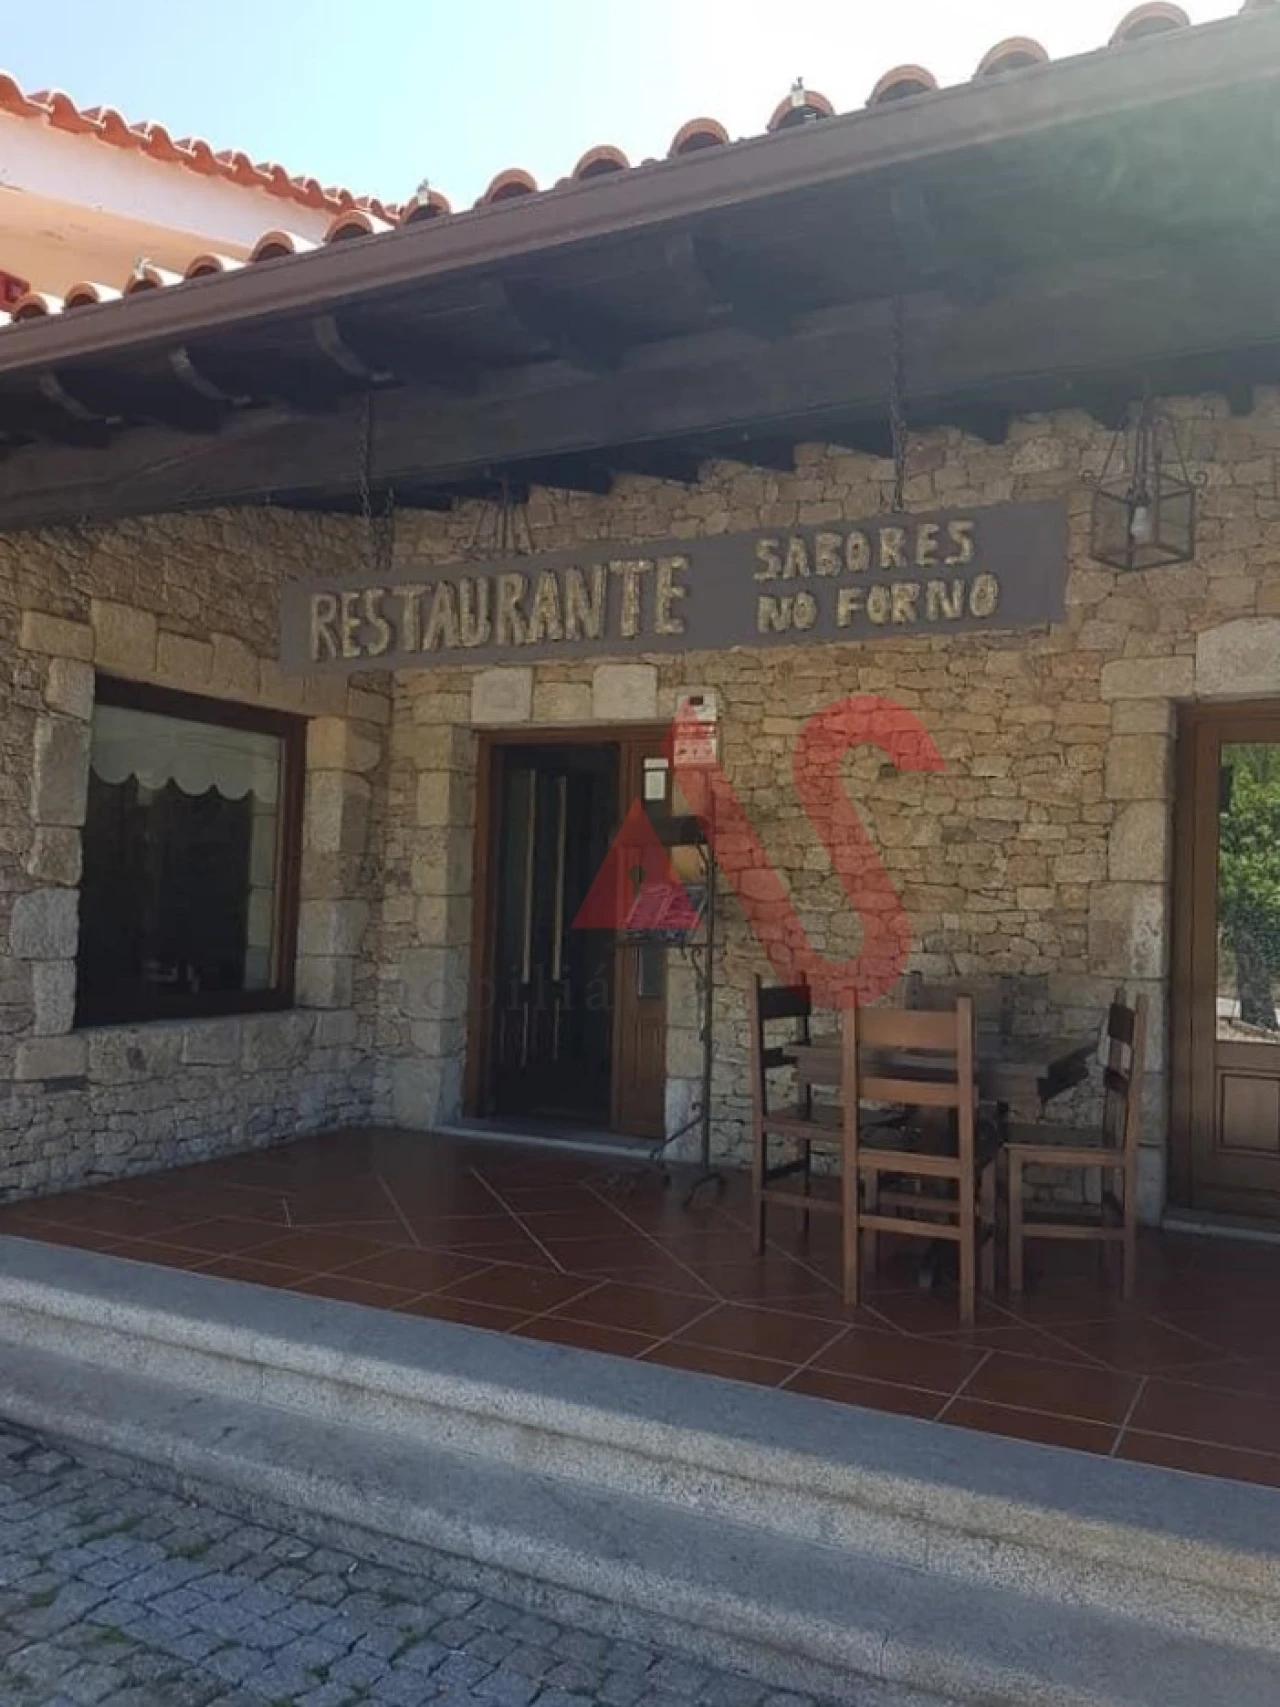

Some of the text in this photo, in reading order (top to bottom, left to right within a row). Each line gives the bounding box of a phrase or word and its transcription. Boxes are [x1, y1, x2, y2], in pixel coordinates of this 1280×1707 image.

[754, 520, 975, 581] SABORES
[309, 555, 690, 661] RESTAURANTE
[757, 571, 999, 633] NO FORNO
